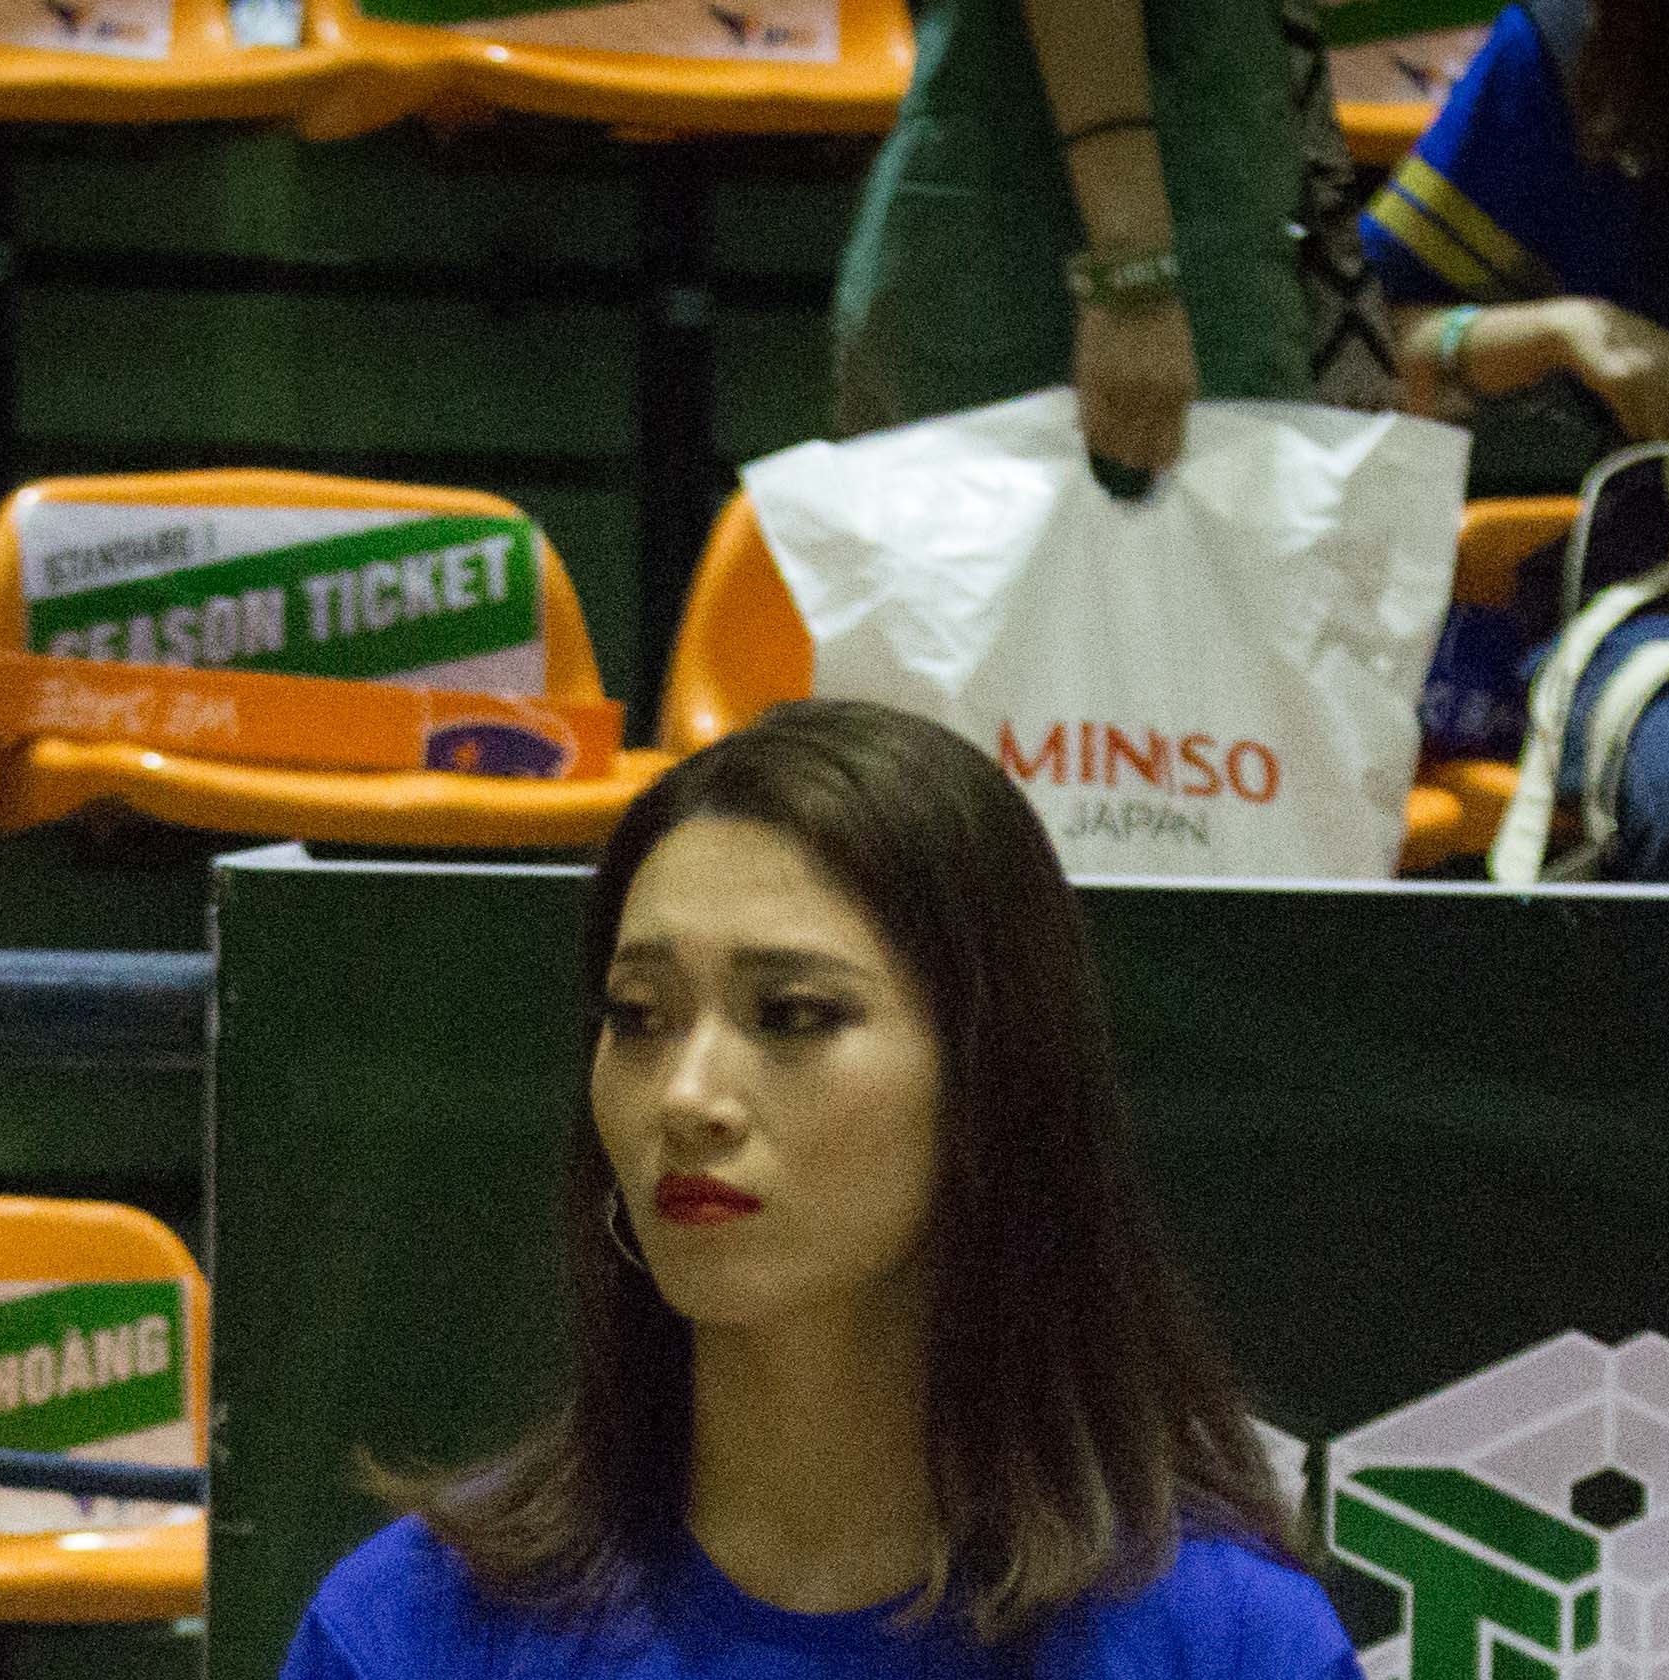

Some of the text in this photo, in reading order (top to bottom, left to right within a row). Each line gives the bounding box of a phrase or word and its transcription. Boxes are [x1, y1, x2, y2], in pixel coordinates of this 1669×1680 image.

[302, 534, 514, 641] TICKET
[996, 719, 1280, 806] MINSO
[1062, 799, 1212, 847] JAPAN
